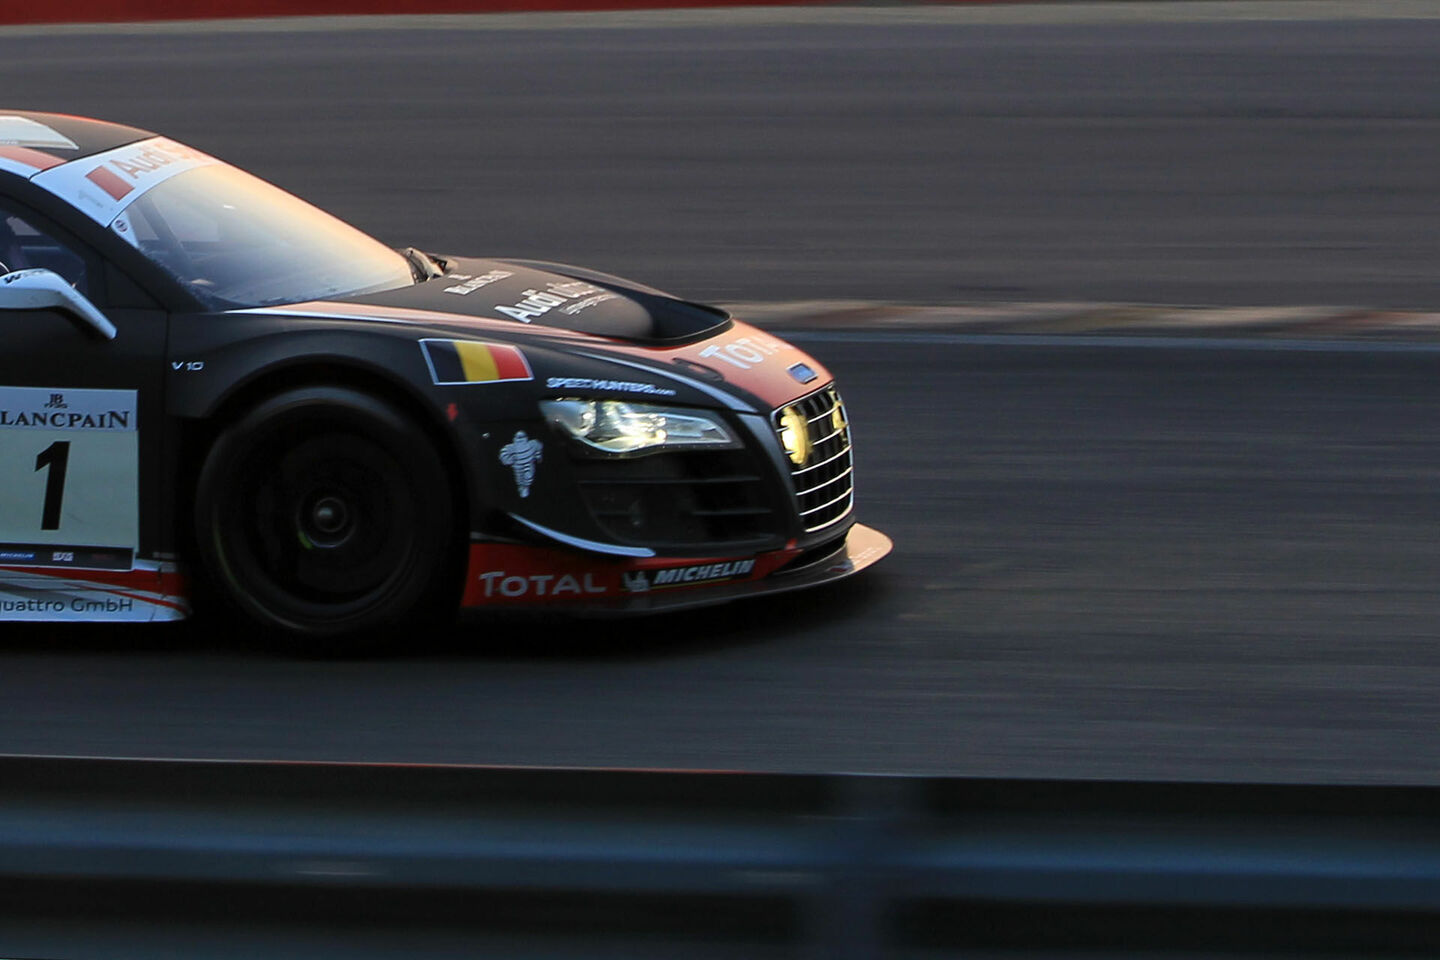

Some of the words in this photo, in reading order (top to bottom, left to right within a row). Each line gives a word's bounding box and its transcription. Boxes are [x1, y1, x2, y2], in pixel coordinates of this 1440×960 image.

[34, 441, 71, 531] 1
[478, 570, 608, 598] TOTAL
[653, 558, 757, 585] MICHELIN
[70, 598, 134, 613] GmbH
